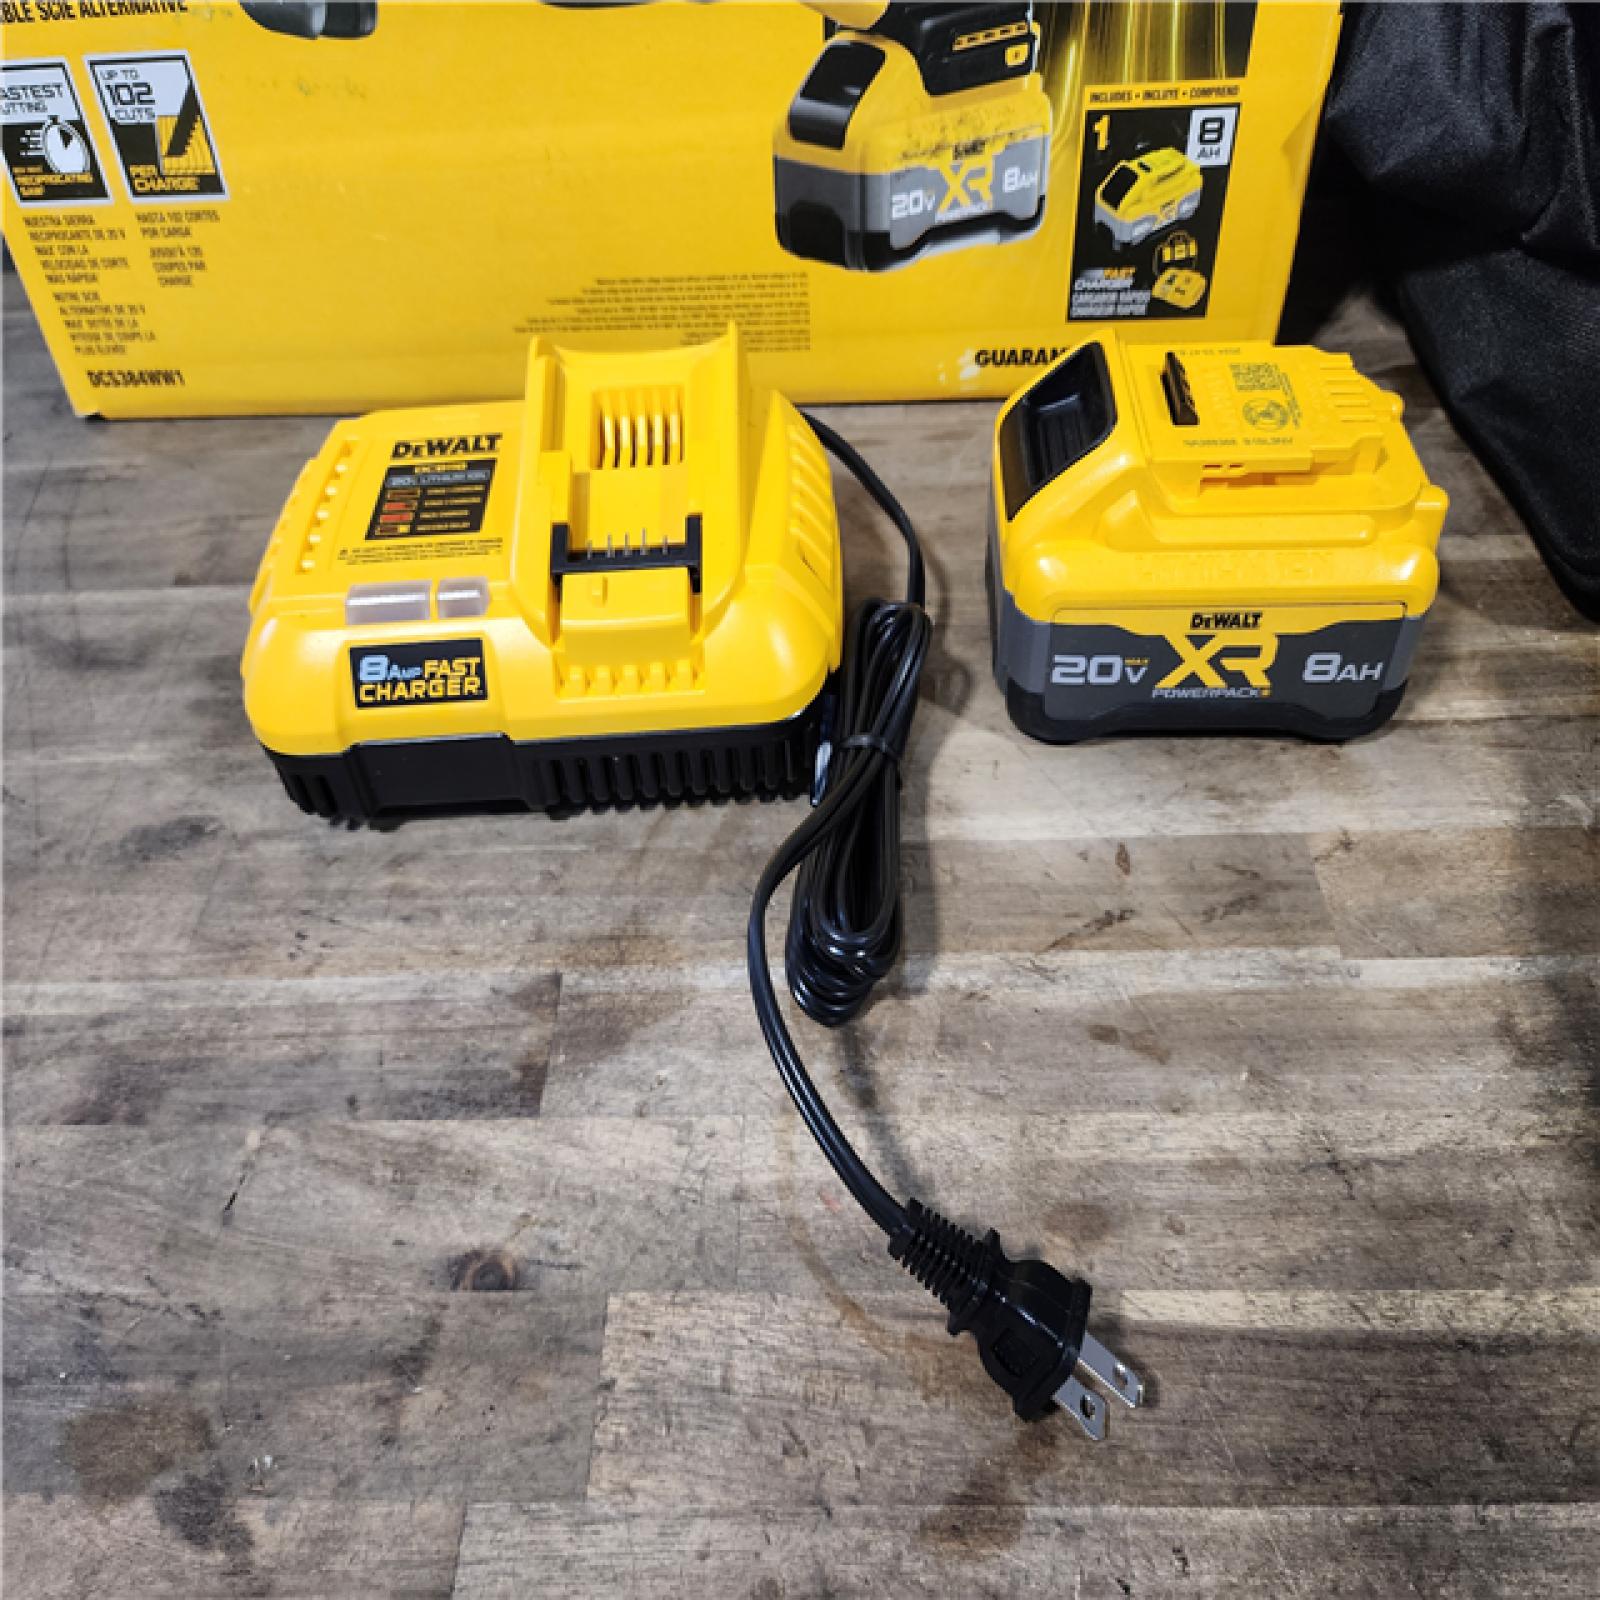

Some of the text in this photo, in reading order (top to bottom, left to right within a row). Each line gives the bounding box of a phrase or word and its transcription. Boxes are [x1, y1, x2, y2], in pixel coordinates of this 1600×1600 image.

[0, 2, 188, 23] BLE SCIE ALTERNATIVE
[101, 69, 139, 80] UP TO
[105, 82, 155, 105] 102
[1090, 89, 1132, 103] INCLUDES
[1143, 88, 1178, 101] INCLUYE
[115, 108, 155, 121] CUTS
[1093, 115, 1110, 150] 1
[1199, 117, 1225, 144] 8
[1197, 147, 1221, 160] AH
[130, 164, 157, 178] PER
[424, 656, 481, 678] FAST
[1153, 633, 1279, 688] XR
[1303, 652, 1383, 684] 8AH
[359, 676, 481, 703] CHARGER
